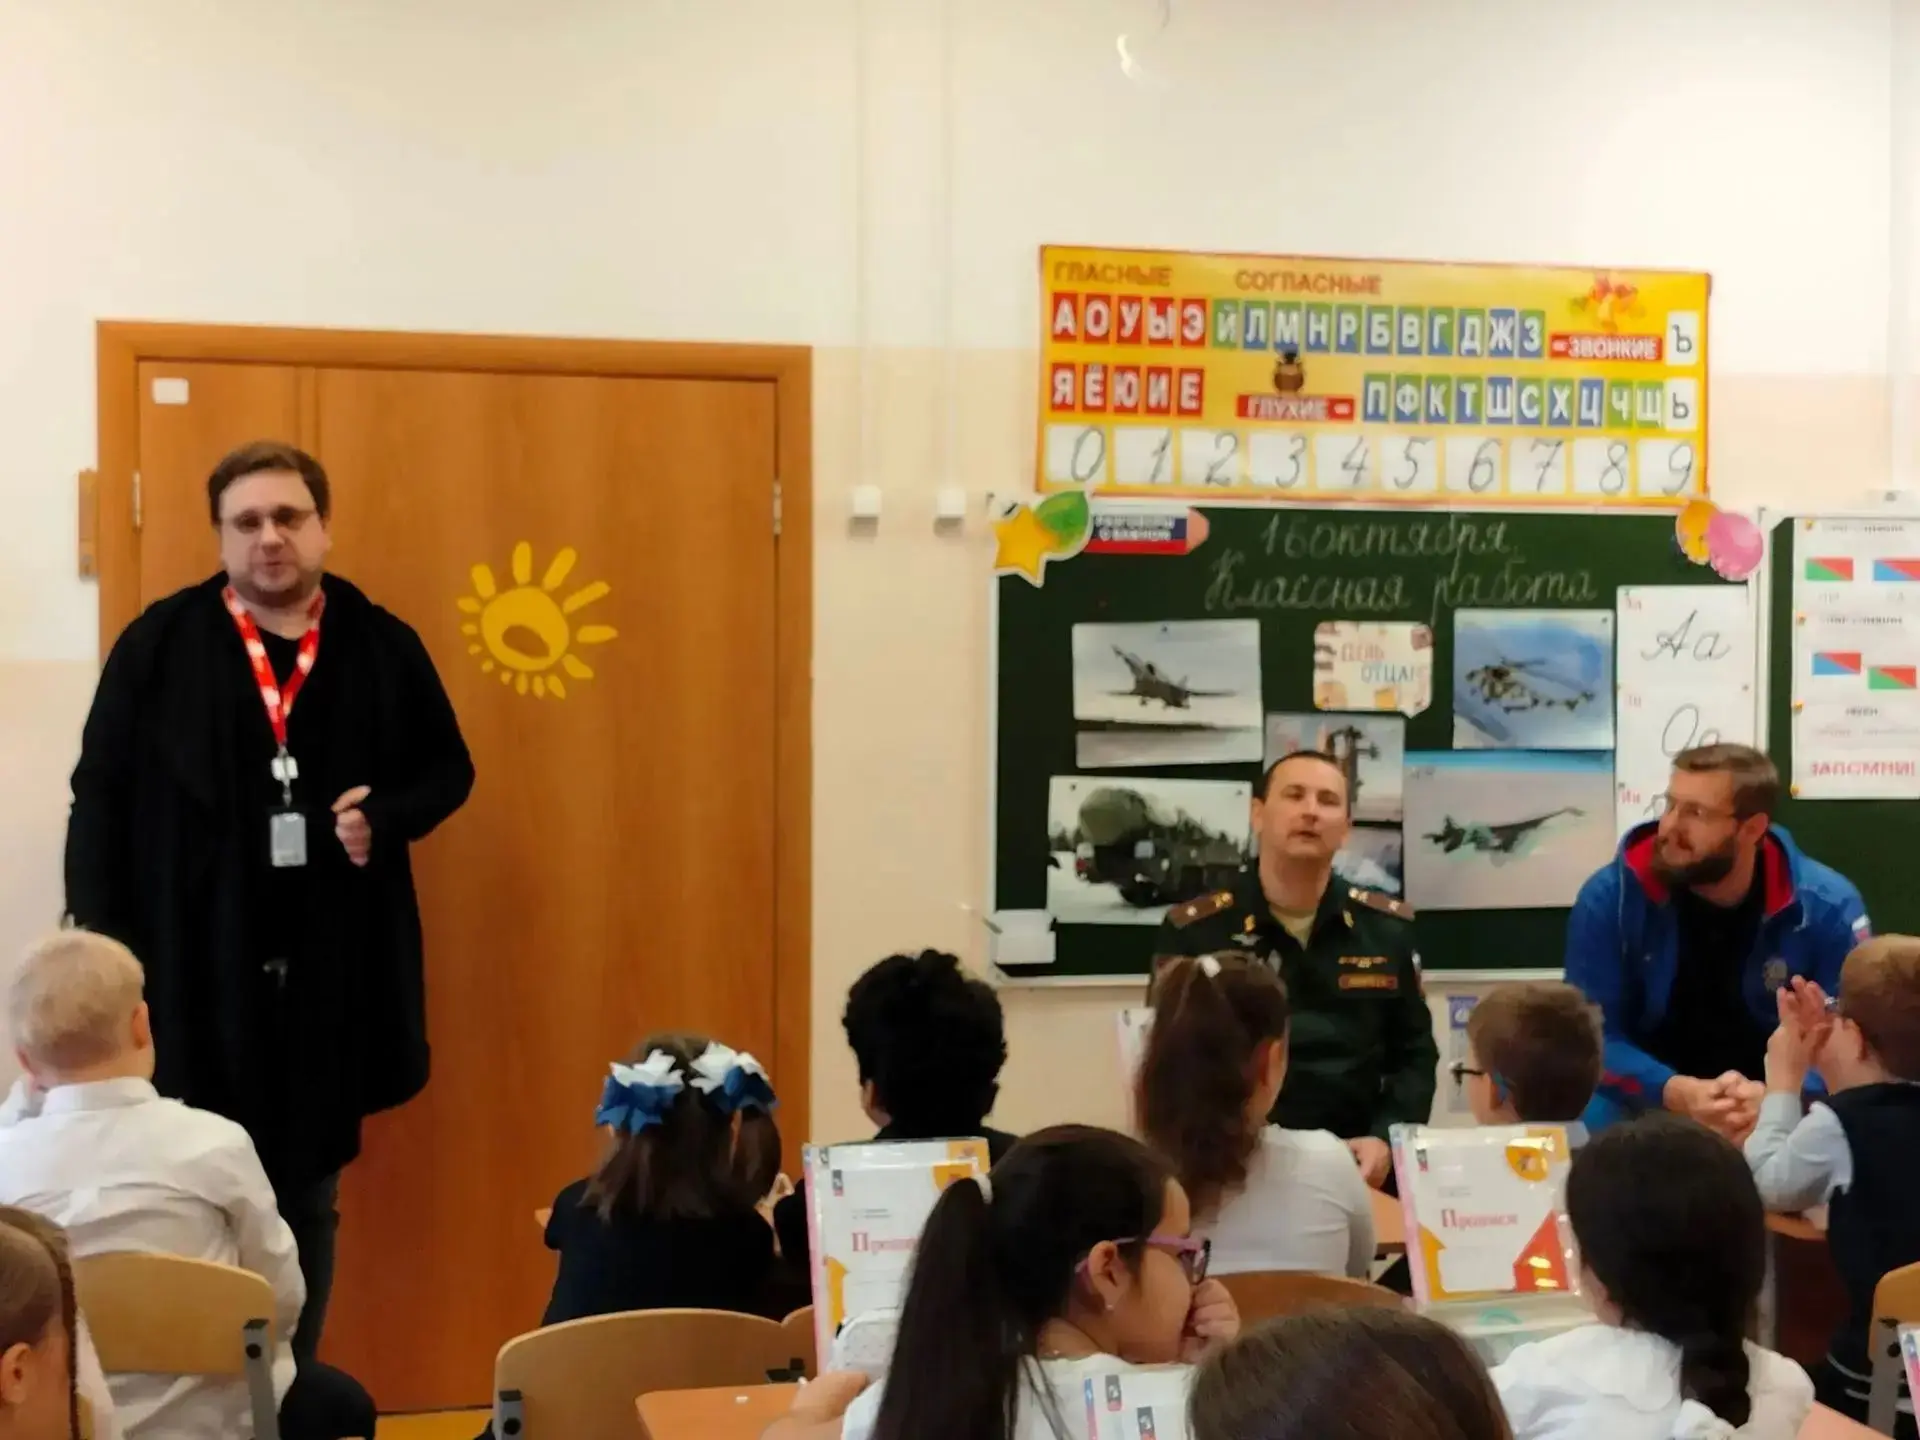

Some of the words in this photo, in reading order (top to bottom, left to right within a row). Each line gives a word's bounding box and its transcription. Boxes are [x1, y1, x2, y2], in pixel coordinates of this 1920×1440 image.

[1053, 261, 1172, 286] ГЛАСНЫЕ
[1235, 270, 1382, 294] СОГЛАСНЫЕ
[1247, 396, 1328, 419] ГЛУХИЕ
[1071, 427, 1106, 482] 0
[1149, 429, 1173, 485] 1
[1205, 432, 1238, 487] 2
[1274, 432, 1307, 489] 3
[1341, 435, 1370, 486] 4
[1393, 438, 1431, 490] 5
[1467, 438, 1503, 493] 6
[1530, 438, 1564, 493] 7
[1599, 440, 1629, 496] 8
[1661, 440, 1694, 497] 9
[1204, 547, 1411, 612] Классная
[1430, 555, 1600, 628] работа
